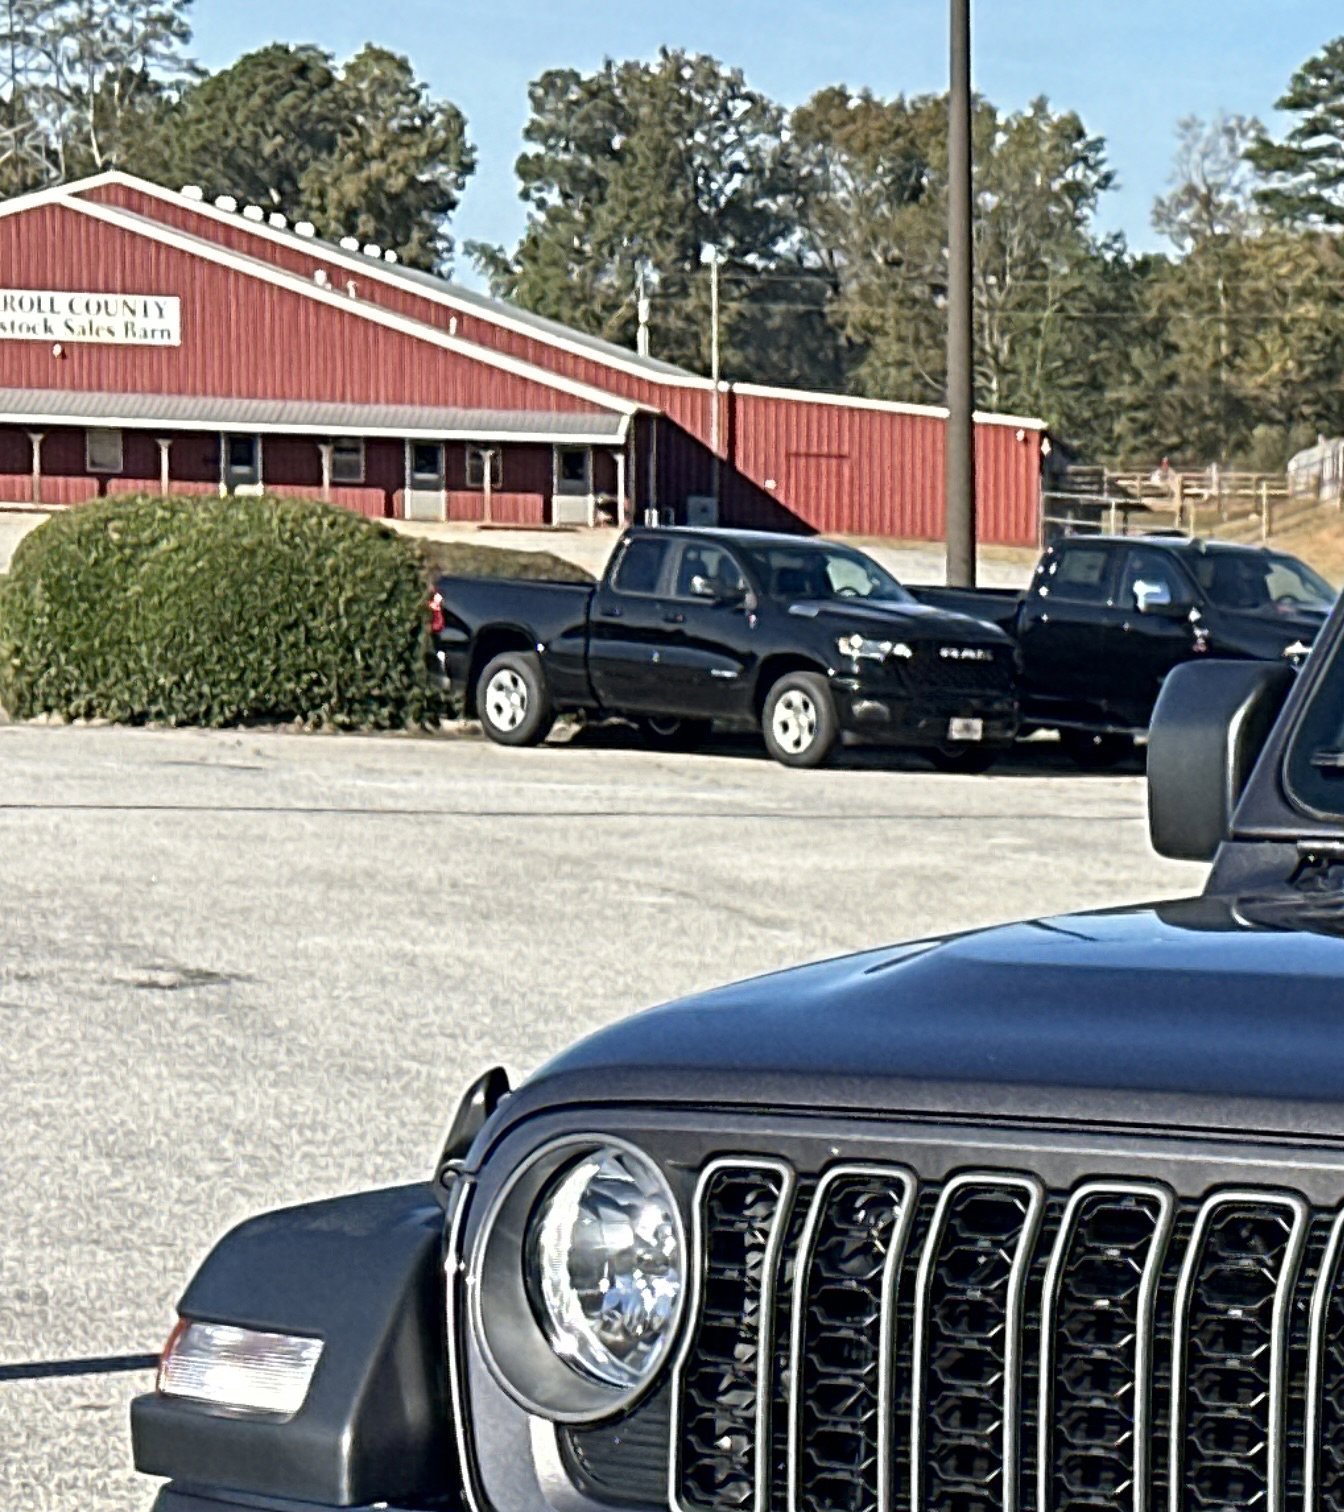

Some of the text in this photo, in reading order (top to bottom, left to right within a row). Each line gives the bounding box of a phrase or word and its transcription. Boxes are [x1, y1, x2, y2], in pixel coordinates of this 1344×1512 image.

[68, 296, 167, 319] COUNTY
[64, 318, 116, 338] Sales
[124, 320, 172, 341] Barn
